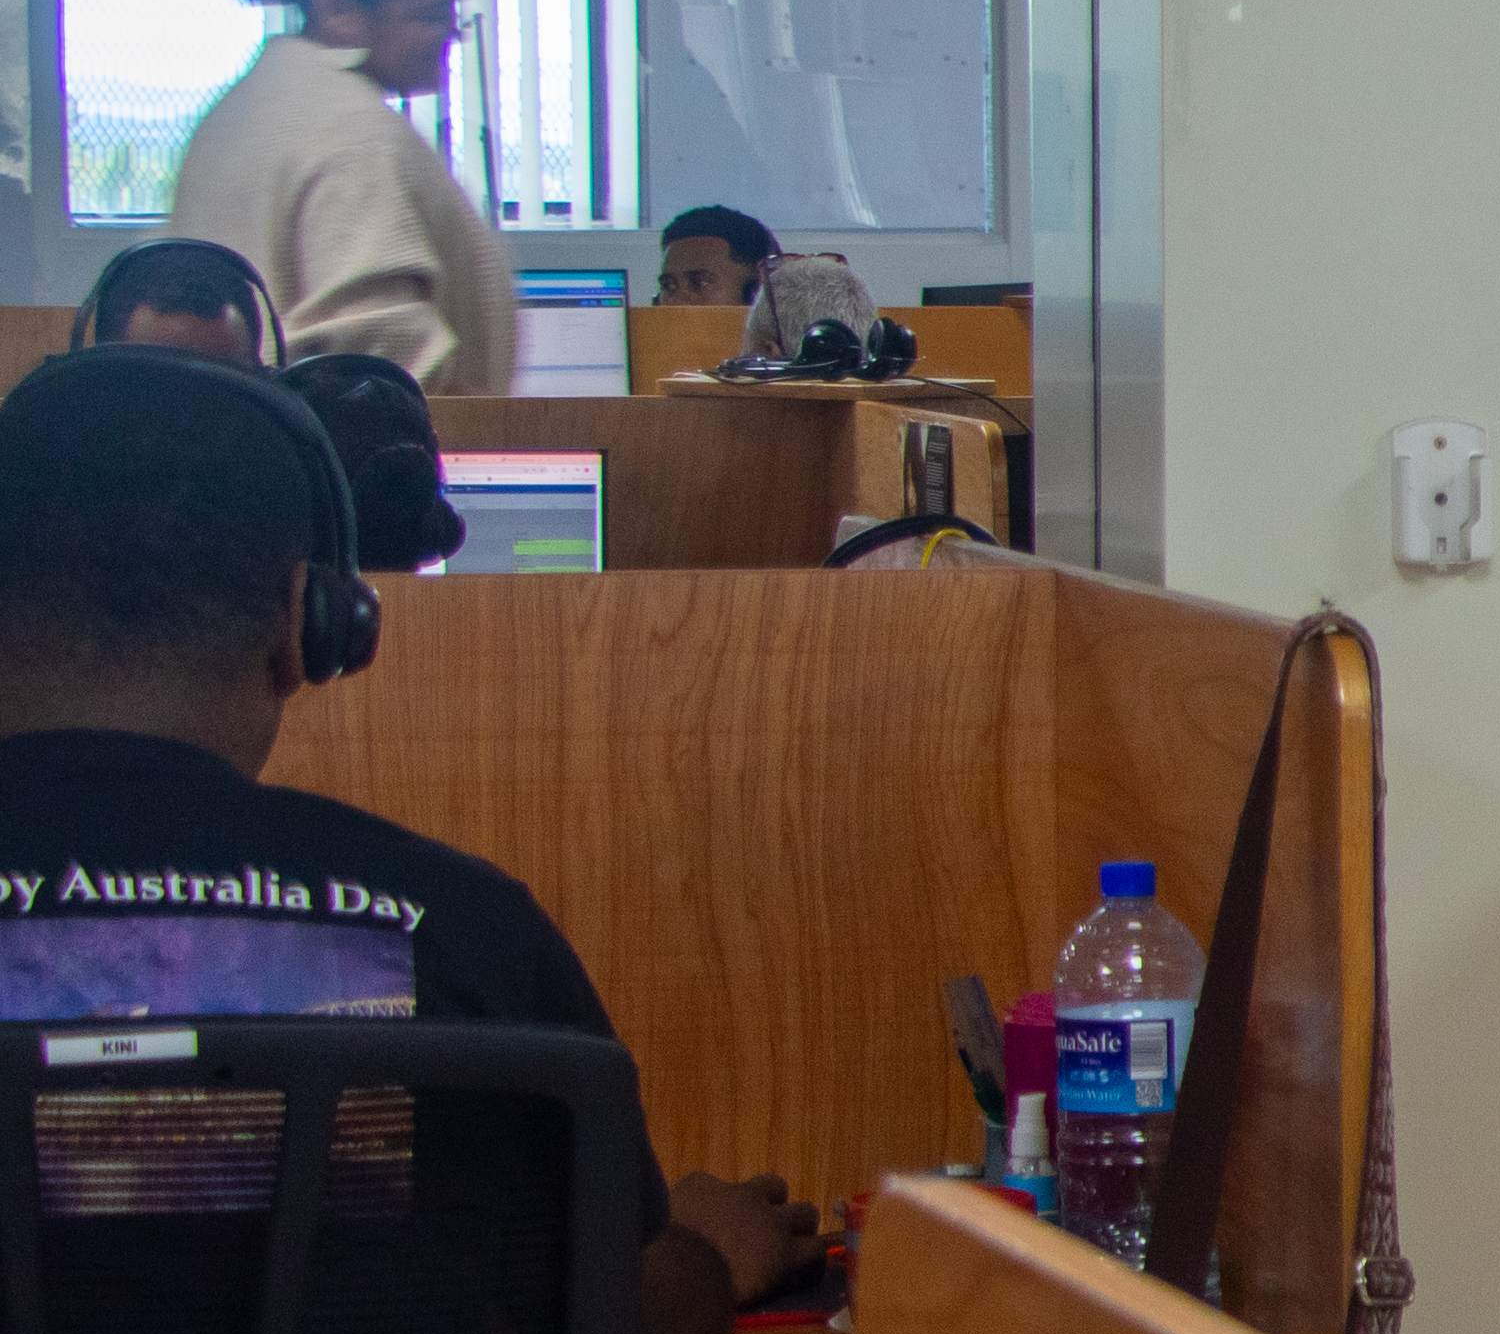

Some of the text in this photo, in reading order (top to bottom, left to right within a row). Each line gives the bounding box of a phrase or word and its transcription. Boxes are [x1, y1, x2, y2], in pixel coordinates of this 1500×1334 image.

[60, 864, 313, 911] Australia
[329, 880, 426, 932] Day
[101, 1038, 138, 1056] KINI
